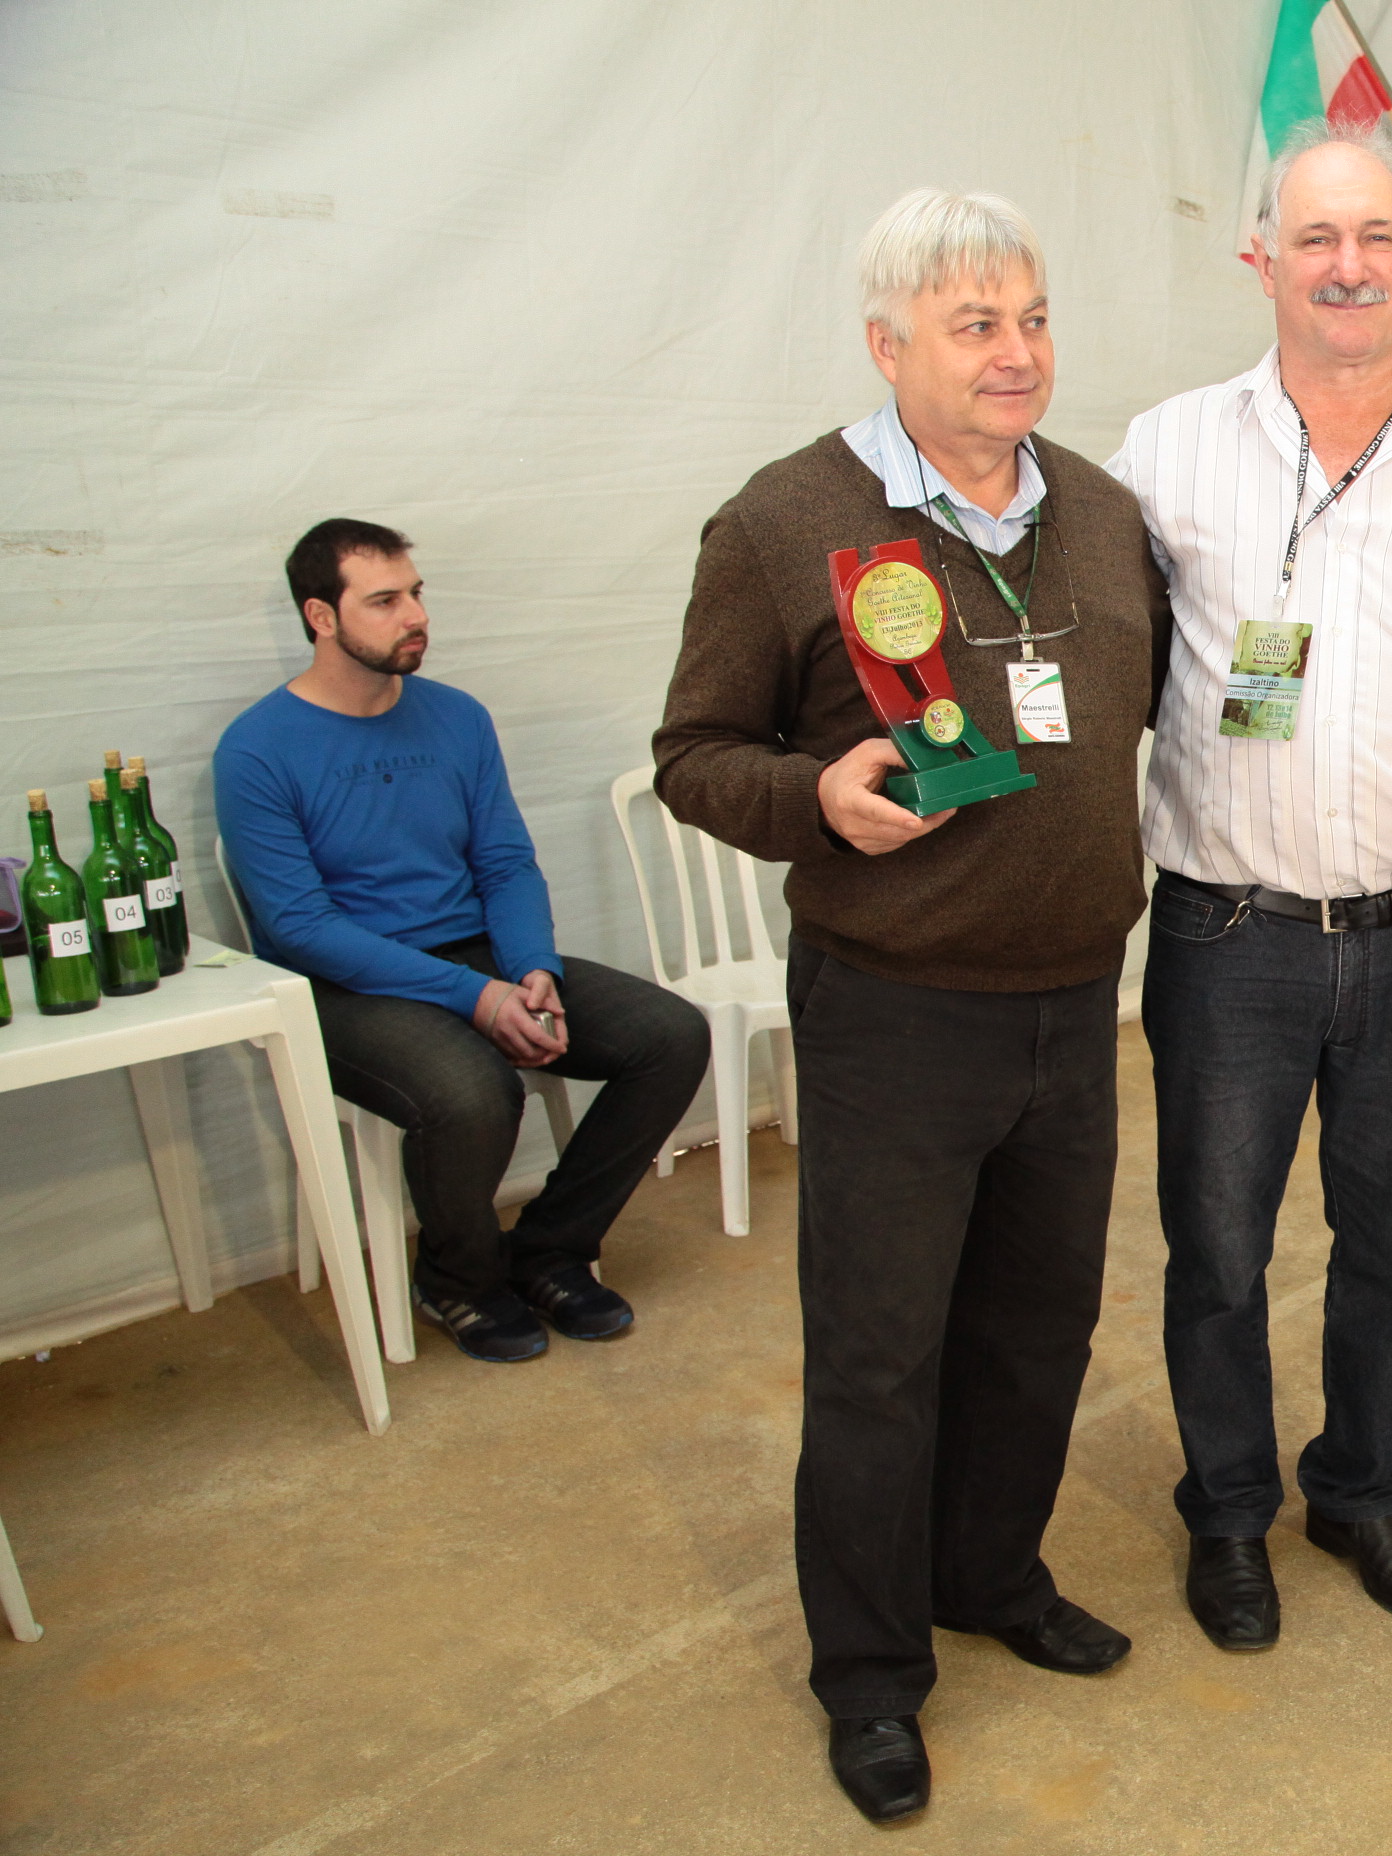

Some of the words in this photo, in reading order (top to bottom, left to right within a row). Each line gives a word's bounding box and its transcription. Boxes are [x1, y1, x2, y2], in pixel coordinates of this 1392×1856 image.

[1299, 434, 1309, 471] GOETHE
[1353, 441, 1380, 471] GOETHE
[1315, 490, 1336, 510] FESTA
[874, 615, 896, 623] VINHO
[897, 609, 924, 620] GOETHE
[889, 605, 910, 614] FESTA
[1255, 643, 1289, 652] VINHO
[1250, 678, 1279, 687] Izaltino
[1226, 689, 1255, 698] Comissão
[1257, 691, 1299, 701] Organizadora
[1021, 704, 1060, 712] Maestrelli
[156, 887, 173, 902] 03
[115, 905, 137, 921] 04
[62, 930, 83, 946] 05
